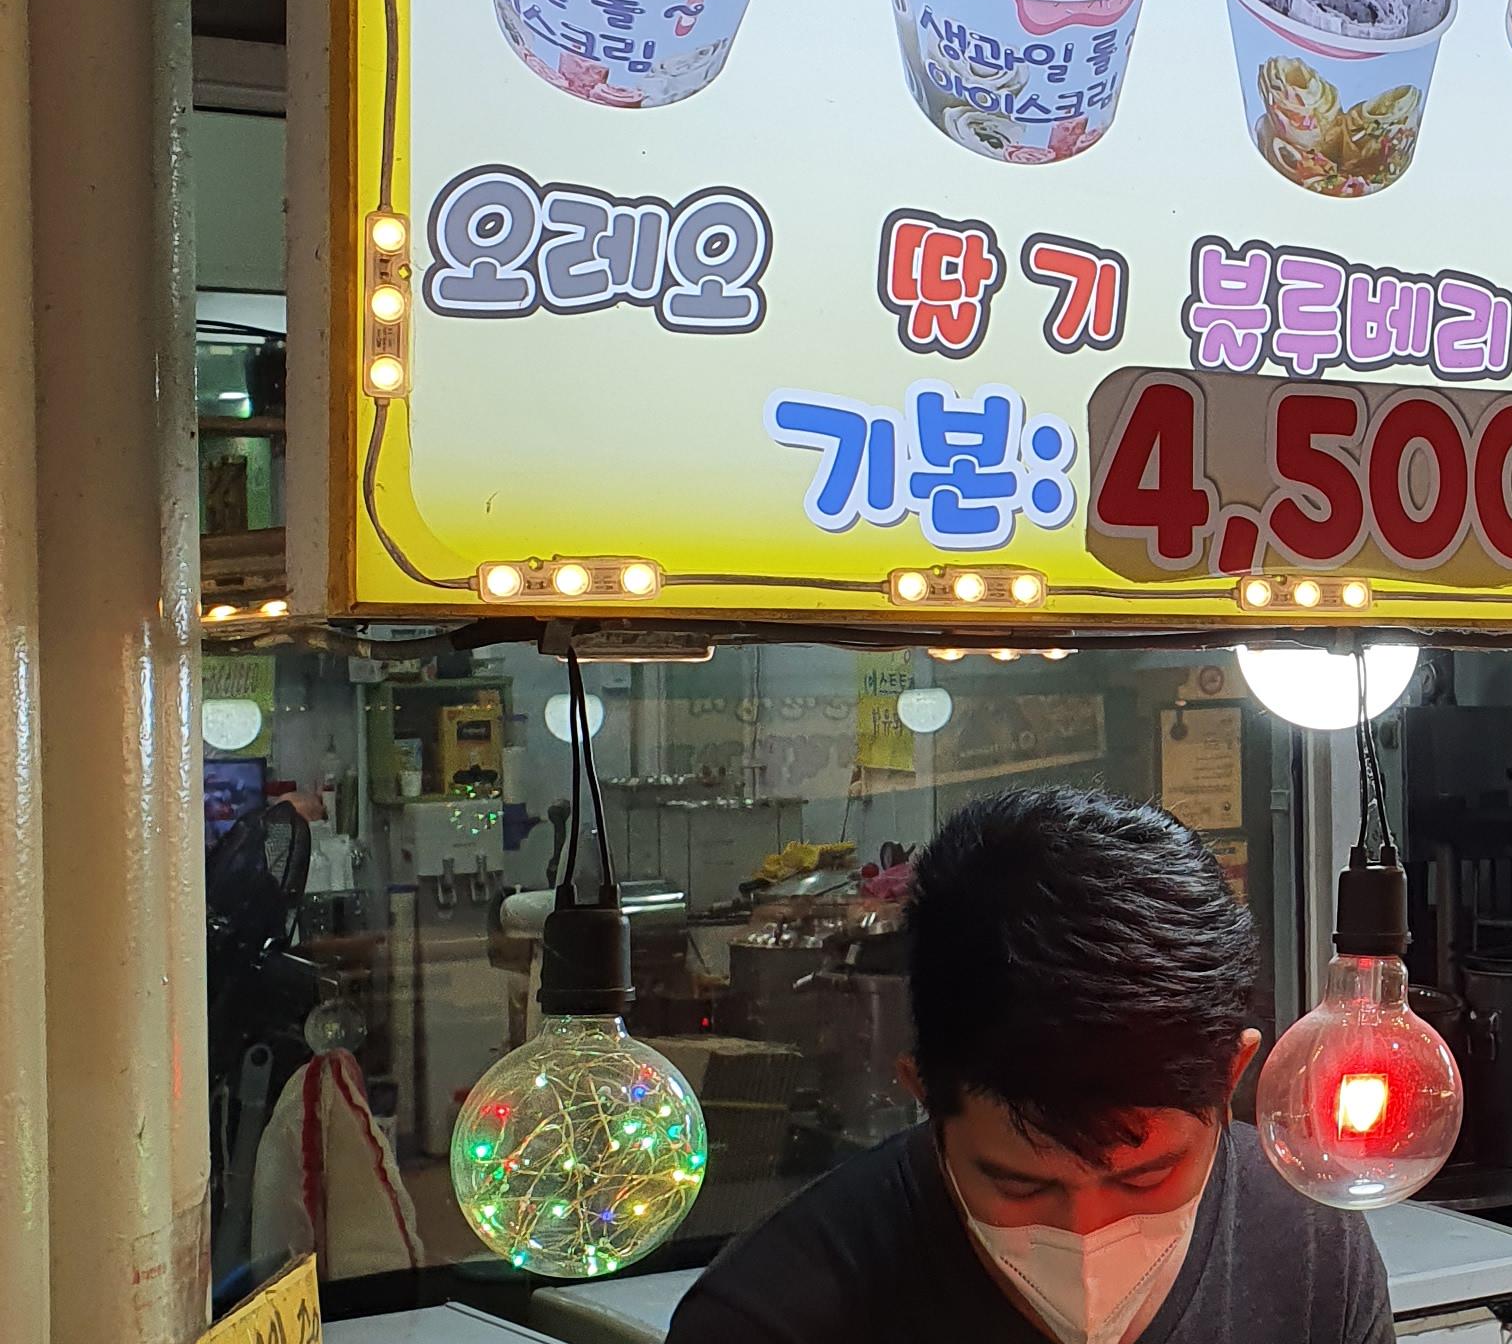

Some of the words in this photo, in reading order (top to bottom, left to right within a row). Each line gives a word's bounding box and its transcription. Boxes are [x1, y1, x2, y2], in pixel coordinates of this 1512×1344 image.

[920, 4, 1074, 84] 생과일
[926, 61, 1118, 124] 아이스크림
[425, 167, 770, 332] 오레오
[765, 380, 1076, 548] 기본:
